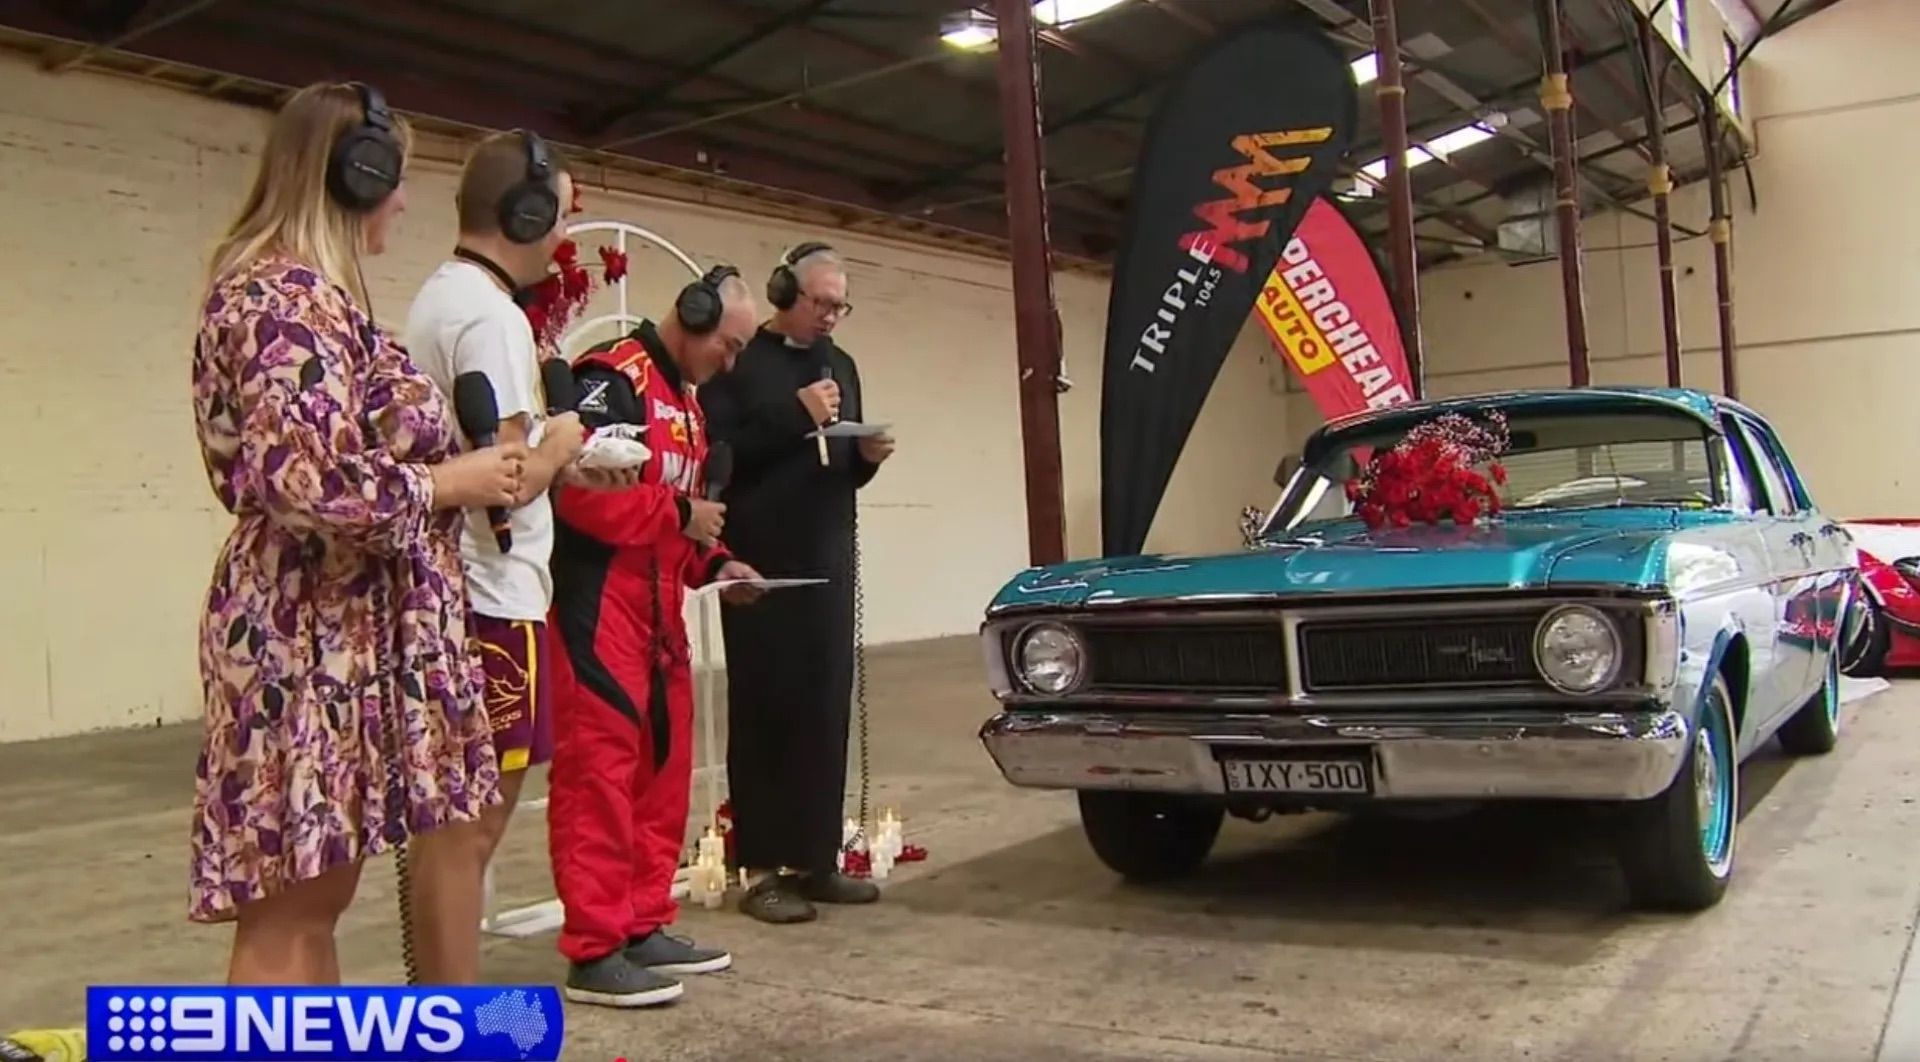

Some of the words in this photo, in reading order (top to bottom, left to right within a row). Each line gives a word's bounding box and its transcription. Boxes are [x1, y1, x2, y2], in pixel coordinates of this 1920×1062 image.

[1129, 234, 1216, 373] TRIPLE
[1195, 268, 1222, 308] 104.5
[1264, 286, 1319, 360] AUTO
